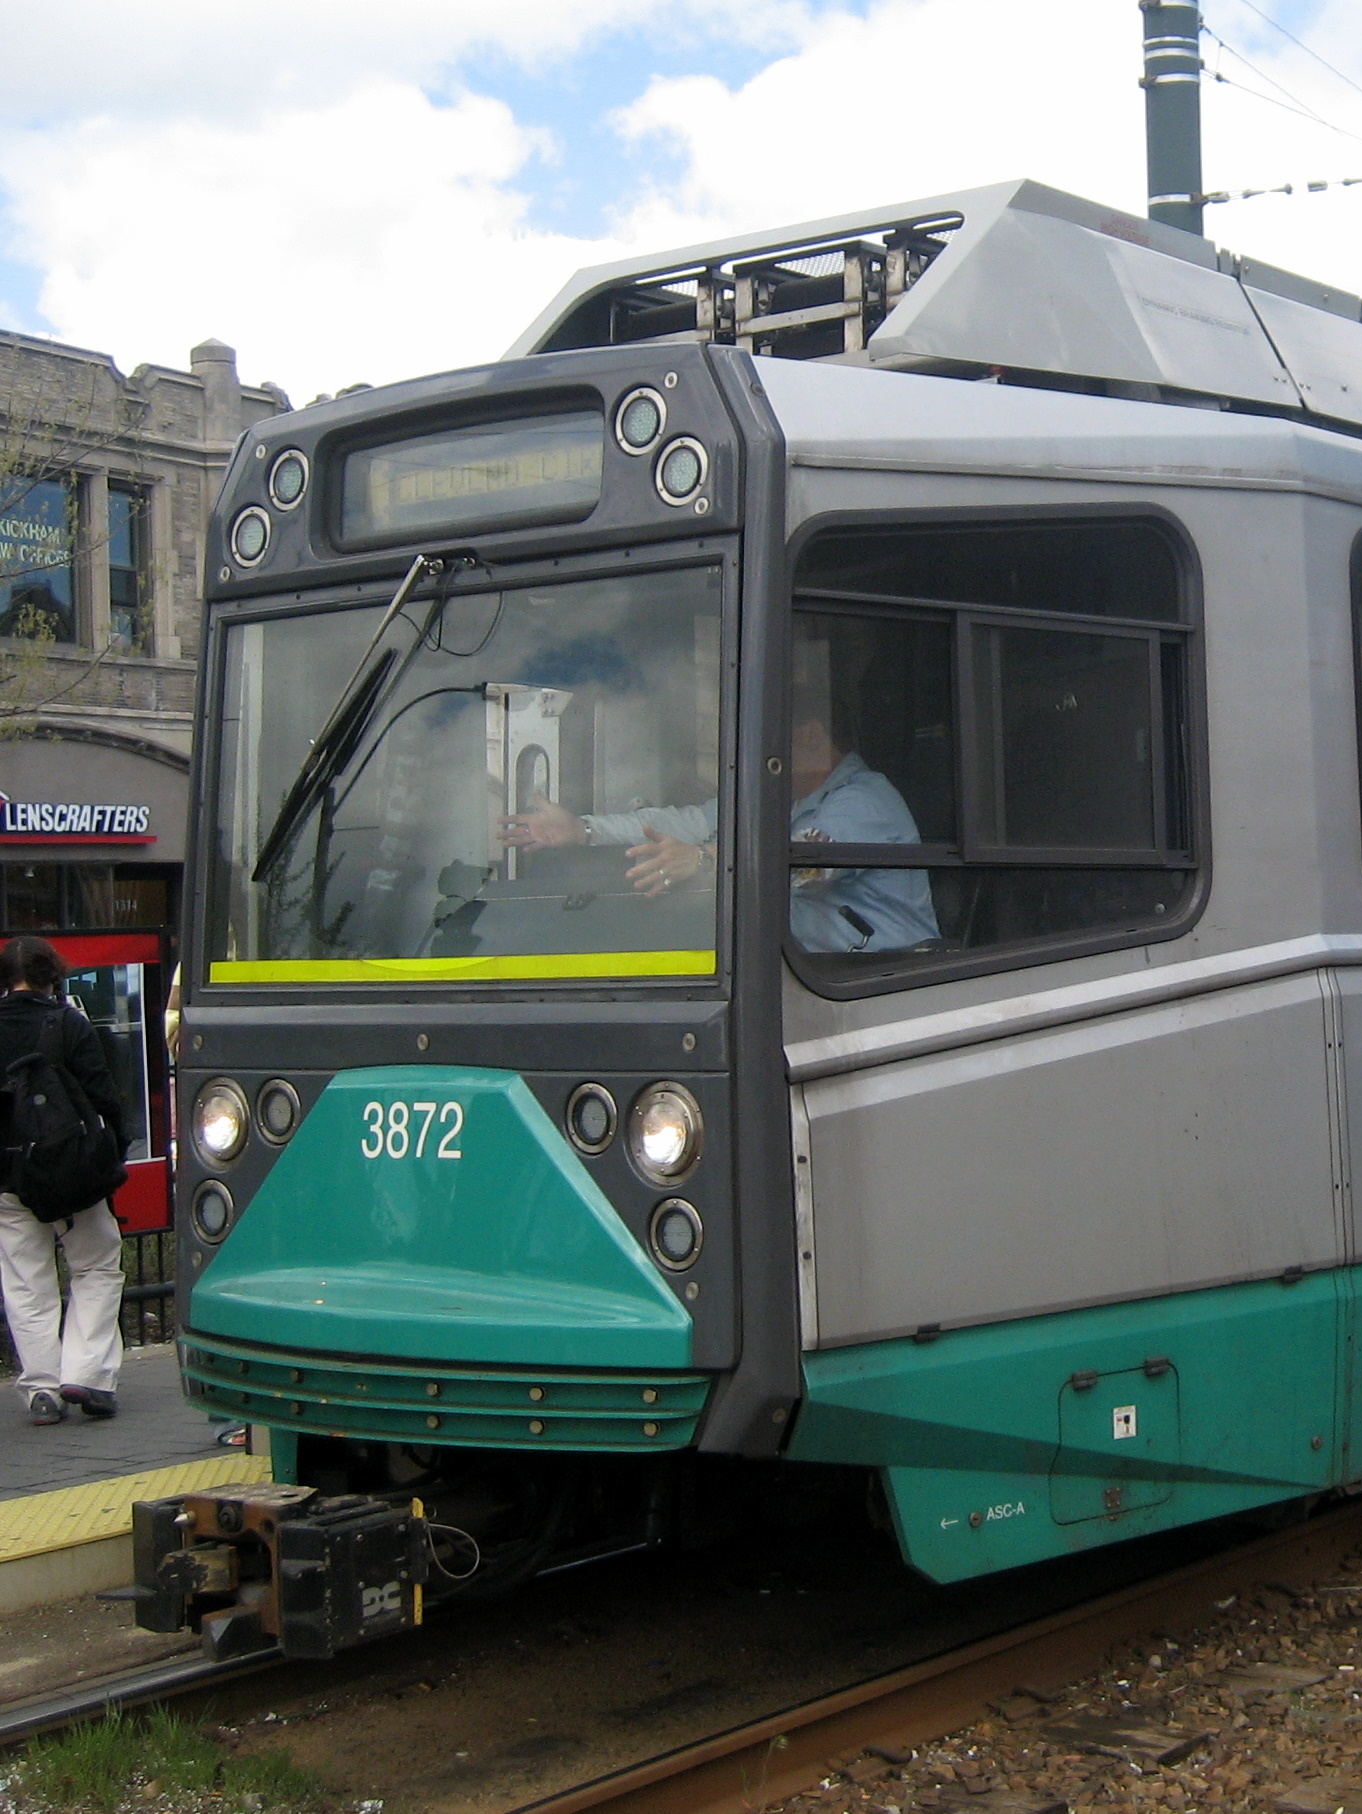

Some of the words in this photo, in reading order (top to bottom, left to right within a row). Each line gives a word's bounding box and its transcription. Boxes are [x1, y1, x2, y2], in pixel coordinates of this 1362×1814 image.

[5, 802, 150, 833] LENSCRAFTERS
[361, 1101, 465, 1160] 3872
[986, 1501, 1026, 1521] ASC-A
